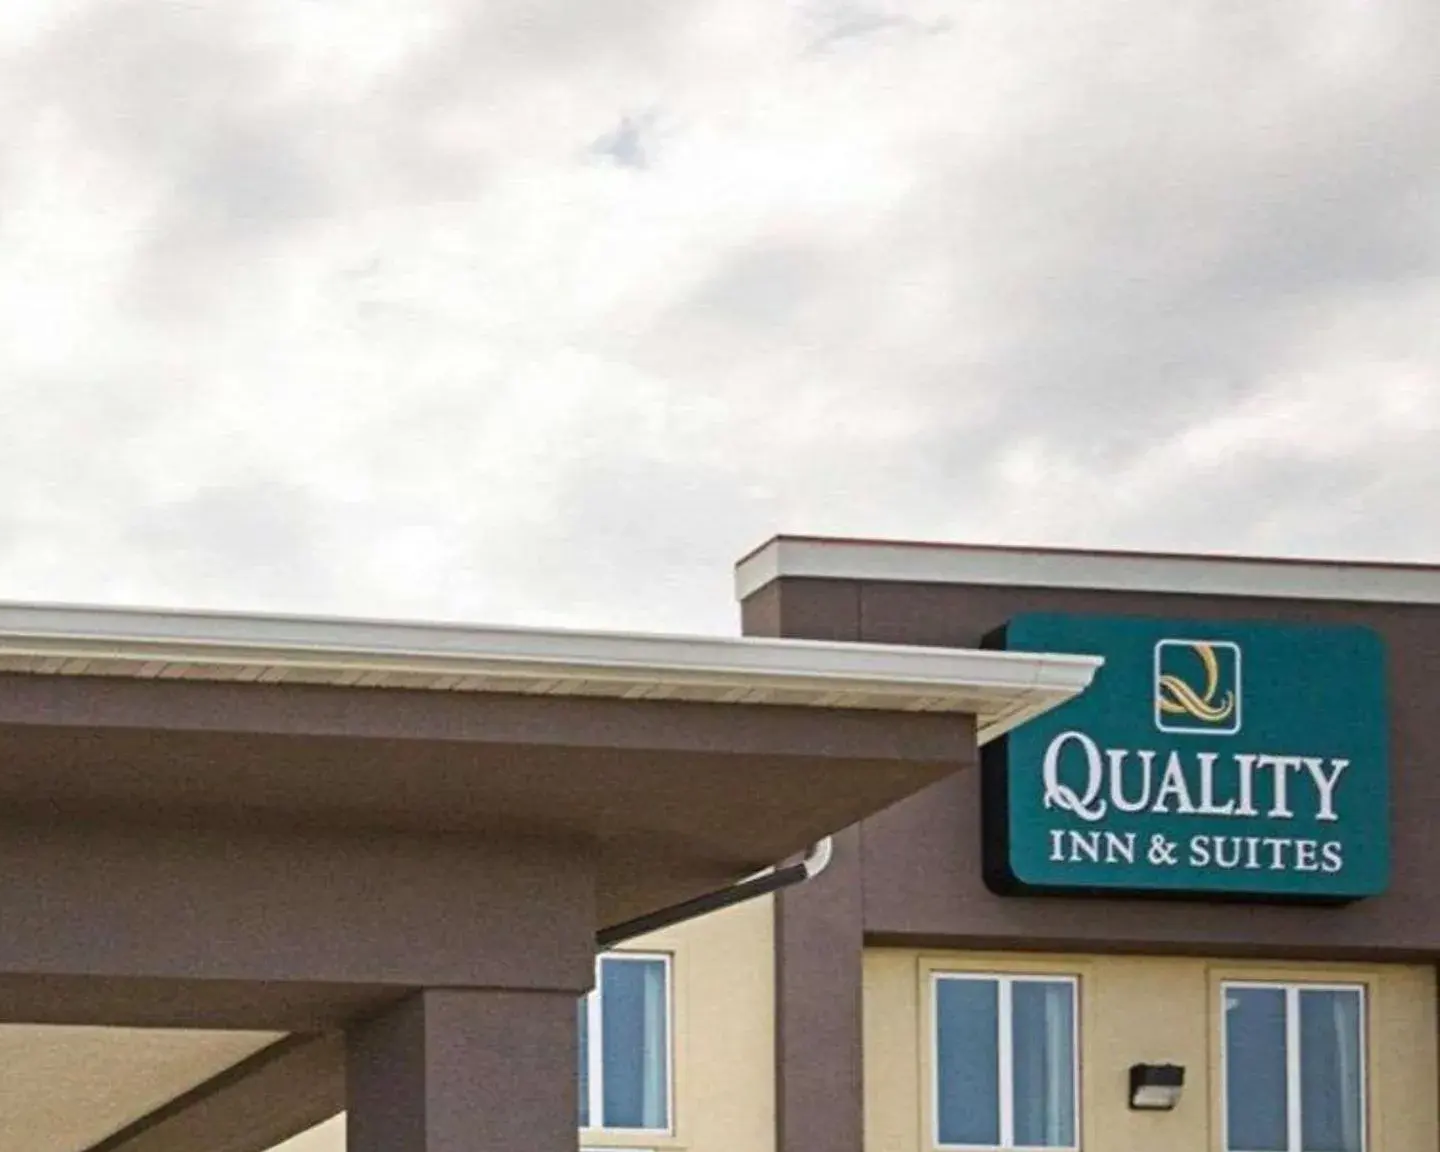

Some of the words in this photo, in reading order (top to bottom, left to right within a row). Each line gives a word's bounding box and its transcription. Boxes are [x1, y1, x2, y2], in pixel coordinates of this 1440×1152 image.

[1042, 730, 1350, 821] QUALITY
[1049, 829, 1137, 863] INN
[1147, 834, 1178, 866] &
[1189, 835, 1343, 873] SUITES
